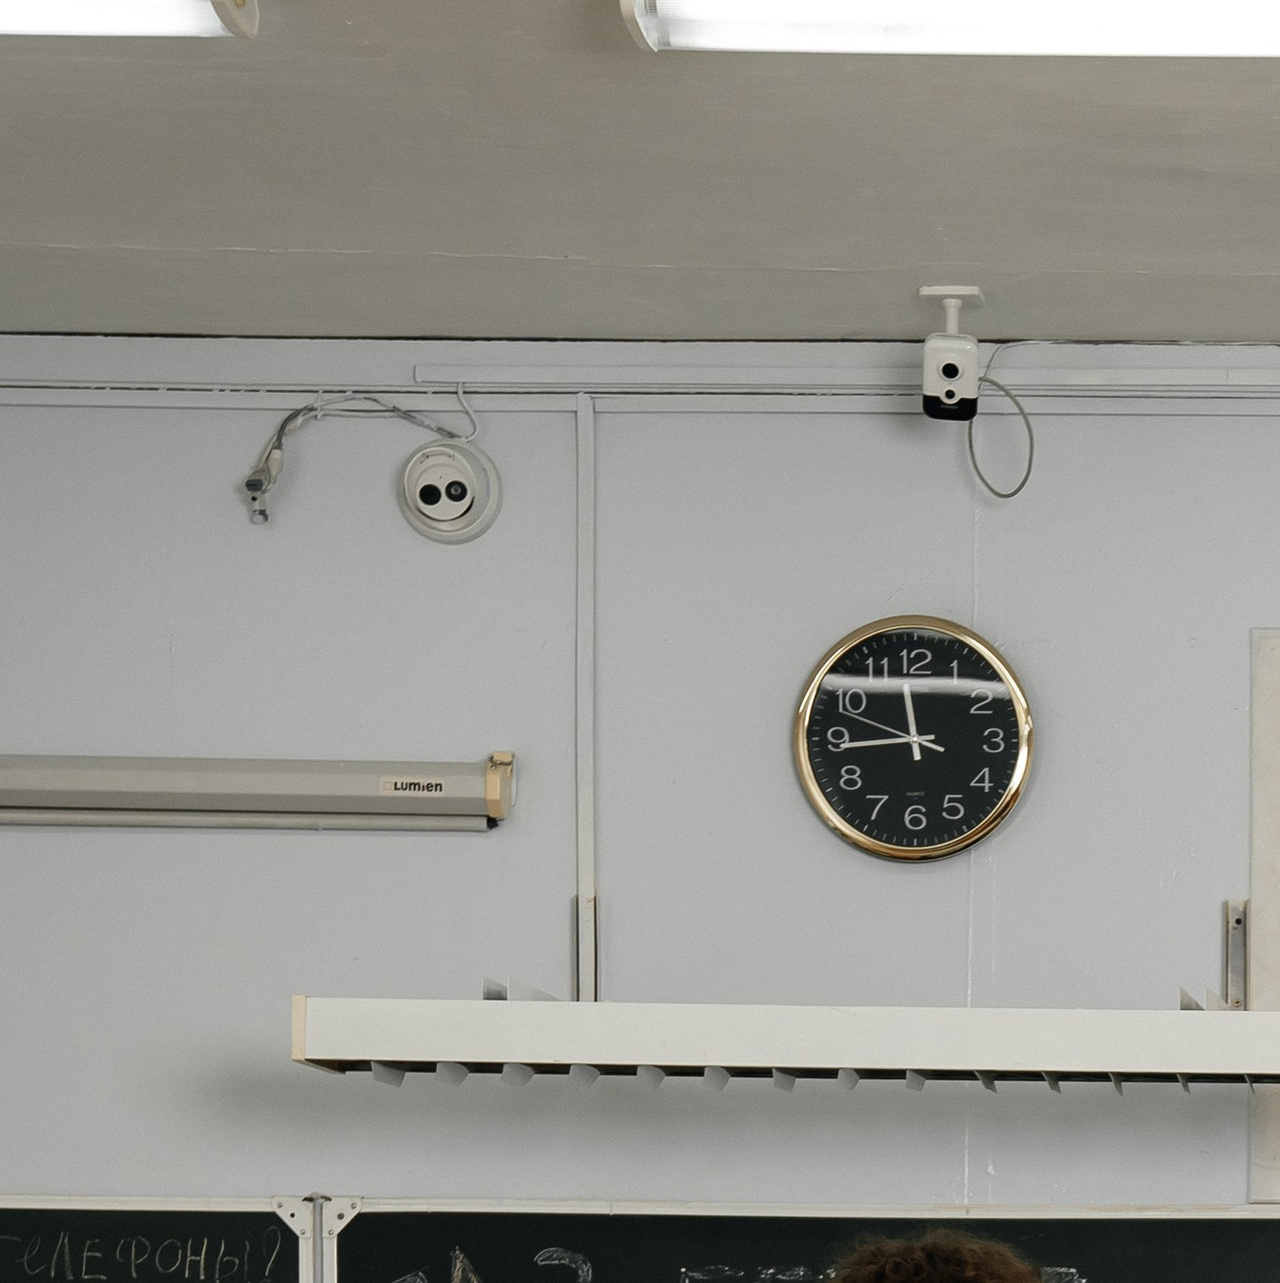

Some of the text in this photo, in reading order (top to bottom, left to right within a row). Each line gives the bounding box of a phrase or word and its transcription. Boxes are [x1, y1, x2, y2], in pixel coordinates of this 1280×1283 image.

[865, 657, 889, 682] 11
[899, 649, 932, 675] 12
[950, 660, 959, 684] 1
[835, 688, 867, 713] 10
[969, 689, 994, 714] 2
[827, 726, 850, 752] 9
[982, 728, 1005, 753] 3
[839, 765, 862, 790] 8
[969, 767, 994, 792] 4
[865, 795, 889, 820] 7
[903, 805, 927, 830] 6
[942, 795, 965, 820] 5
